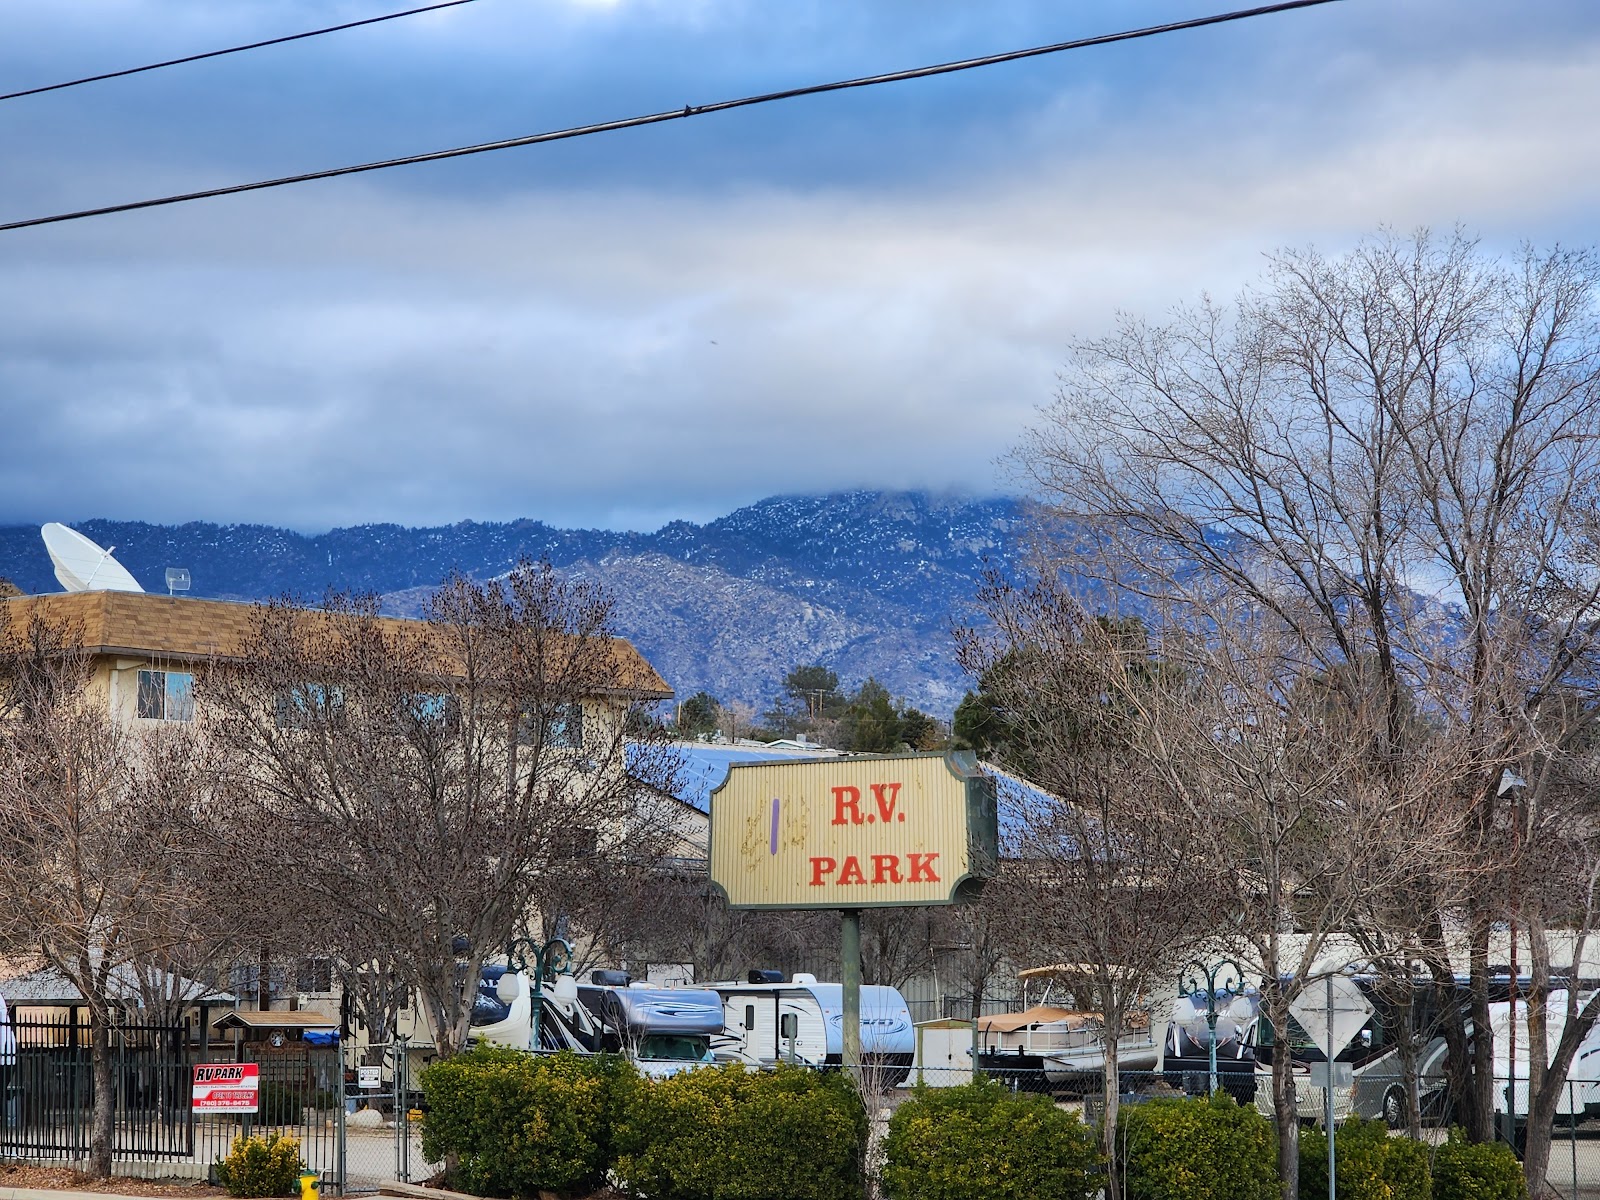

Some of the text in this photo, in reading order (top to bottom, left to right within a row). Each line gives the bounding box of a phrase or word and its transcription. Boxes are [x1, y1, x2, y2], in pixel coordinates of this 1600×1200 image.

[831, 782, 906, 826] R.V.
[809, 852, 941, 886] PARK
[195, 1067, 243, 1081] RV PARK
